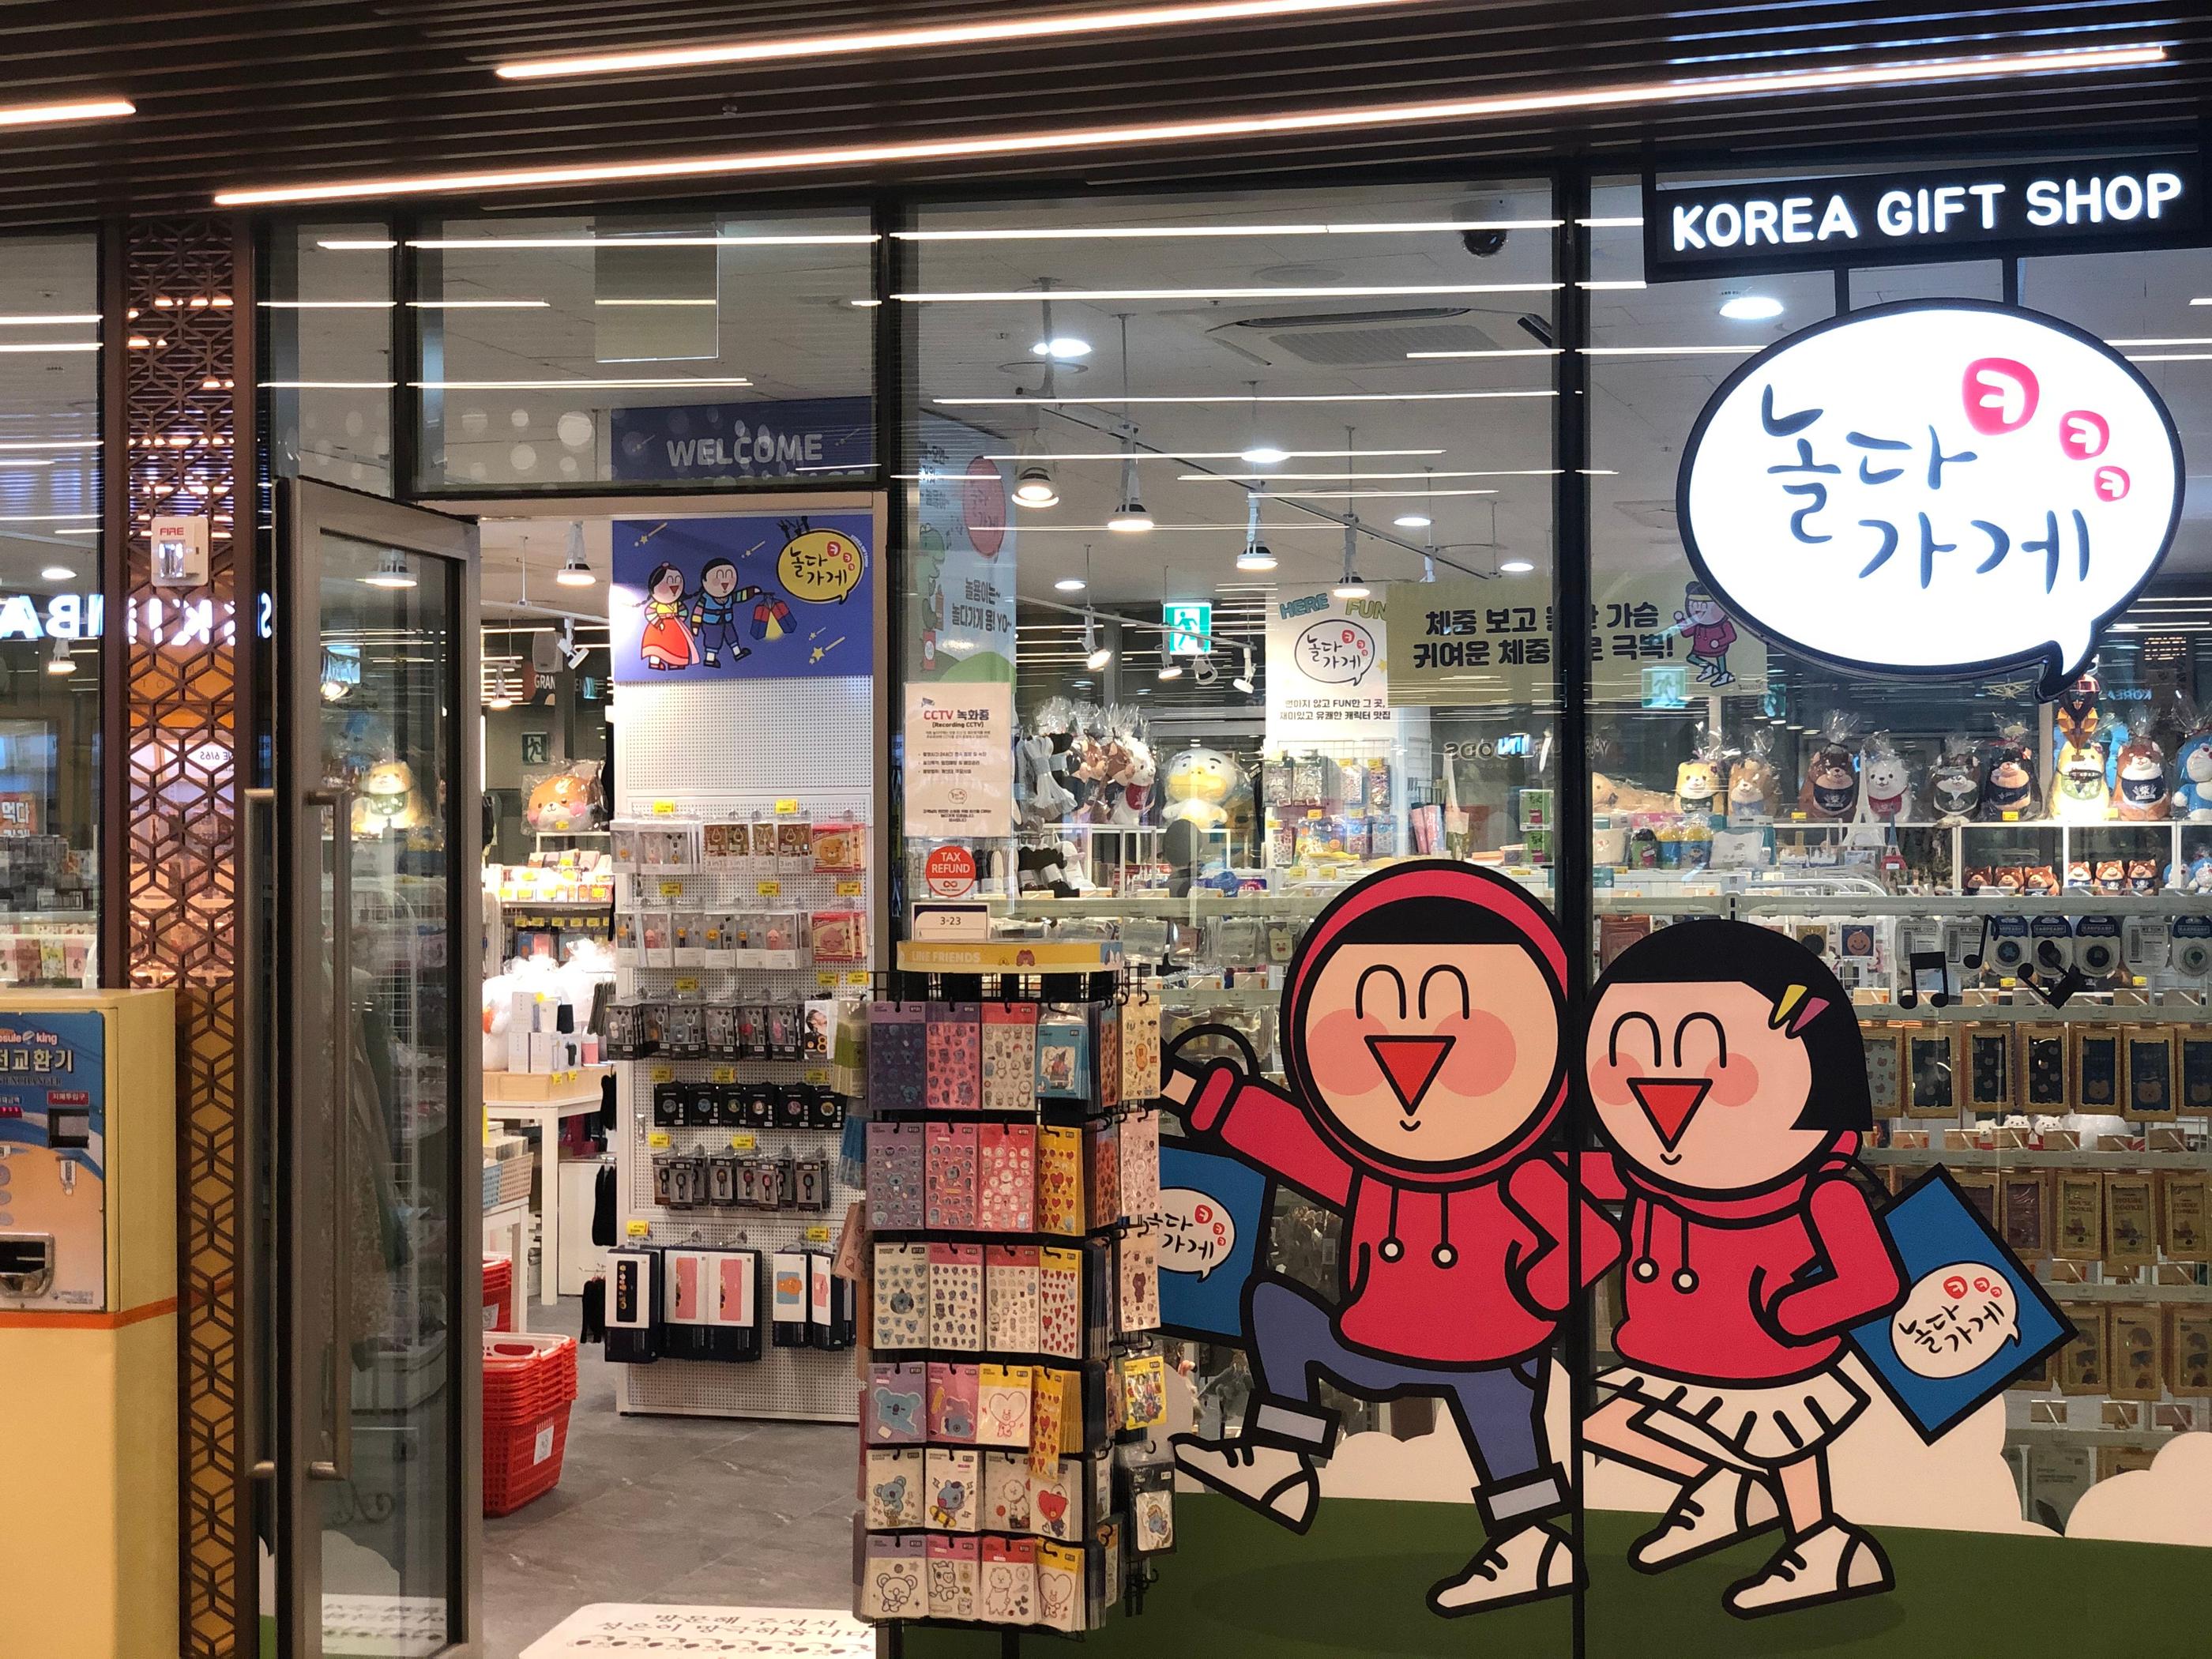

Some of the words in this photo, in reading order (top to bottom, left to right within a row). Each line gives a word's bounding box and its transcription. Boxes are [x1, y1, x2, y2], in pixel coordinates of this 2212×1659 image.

[1672, 194, 1858, 251] KOREA
[1876, 183, 2006, 236] GIFT
[2025, 172, 2183, 226] SHOP
[667, 434, 822, 467] WELCOME
[1762, 384, 1977, 544] 놀다
[160, 527, 184, 536] FIRE
[789, 546, 828, 577] 놀다
[1858, 509, 2090, 594] 가게
[807, 569, 848, 586] 가게
[952, 603, 984, 630] 놀다가게
[1279, 592, 1330, 620] HERE
[1606, 601, 1659, 629] 가슴
[1426, 610, 1477, 635] 체중
[1486, 608, 1537, 634] 보고
[1307, 634, 1342, 662] 놀다
[1413, 641, 1490, 668] 귀여운
[1323, 655, 1360, 669] 가게
[924, 710, 954, 720] CCTV
[957, 709, 989, 720] 녹화중
[1345, 712, 1371, 720] 캐릭터
[931, 863, 970, 874] REFUND
[940, 852, 961, 862] TAX
[939, 916, 961, 926] 3-23
[912, 950, 930, 961] LINE
[932, 951, 981, 963] FRIENDS
[36, 1032, 58, 1045] king
[1162, 1233, 1214, 1261] 가게
[1898, 1304, 1960, 1354] 놀다
[1943, 1300, 2005, 1352] 가게
